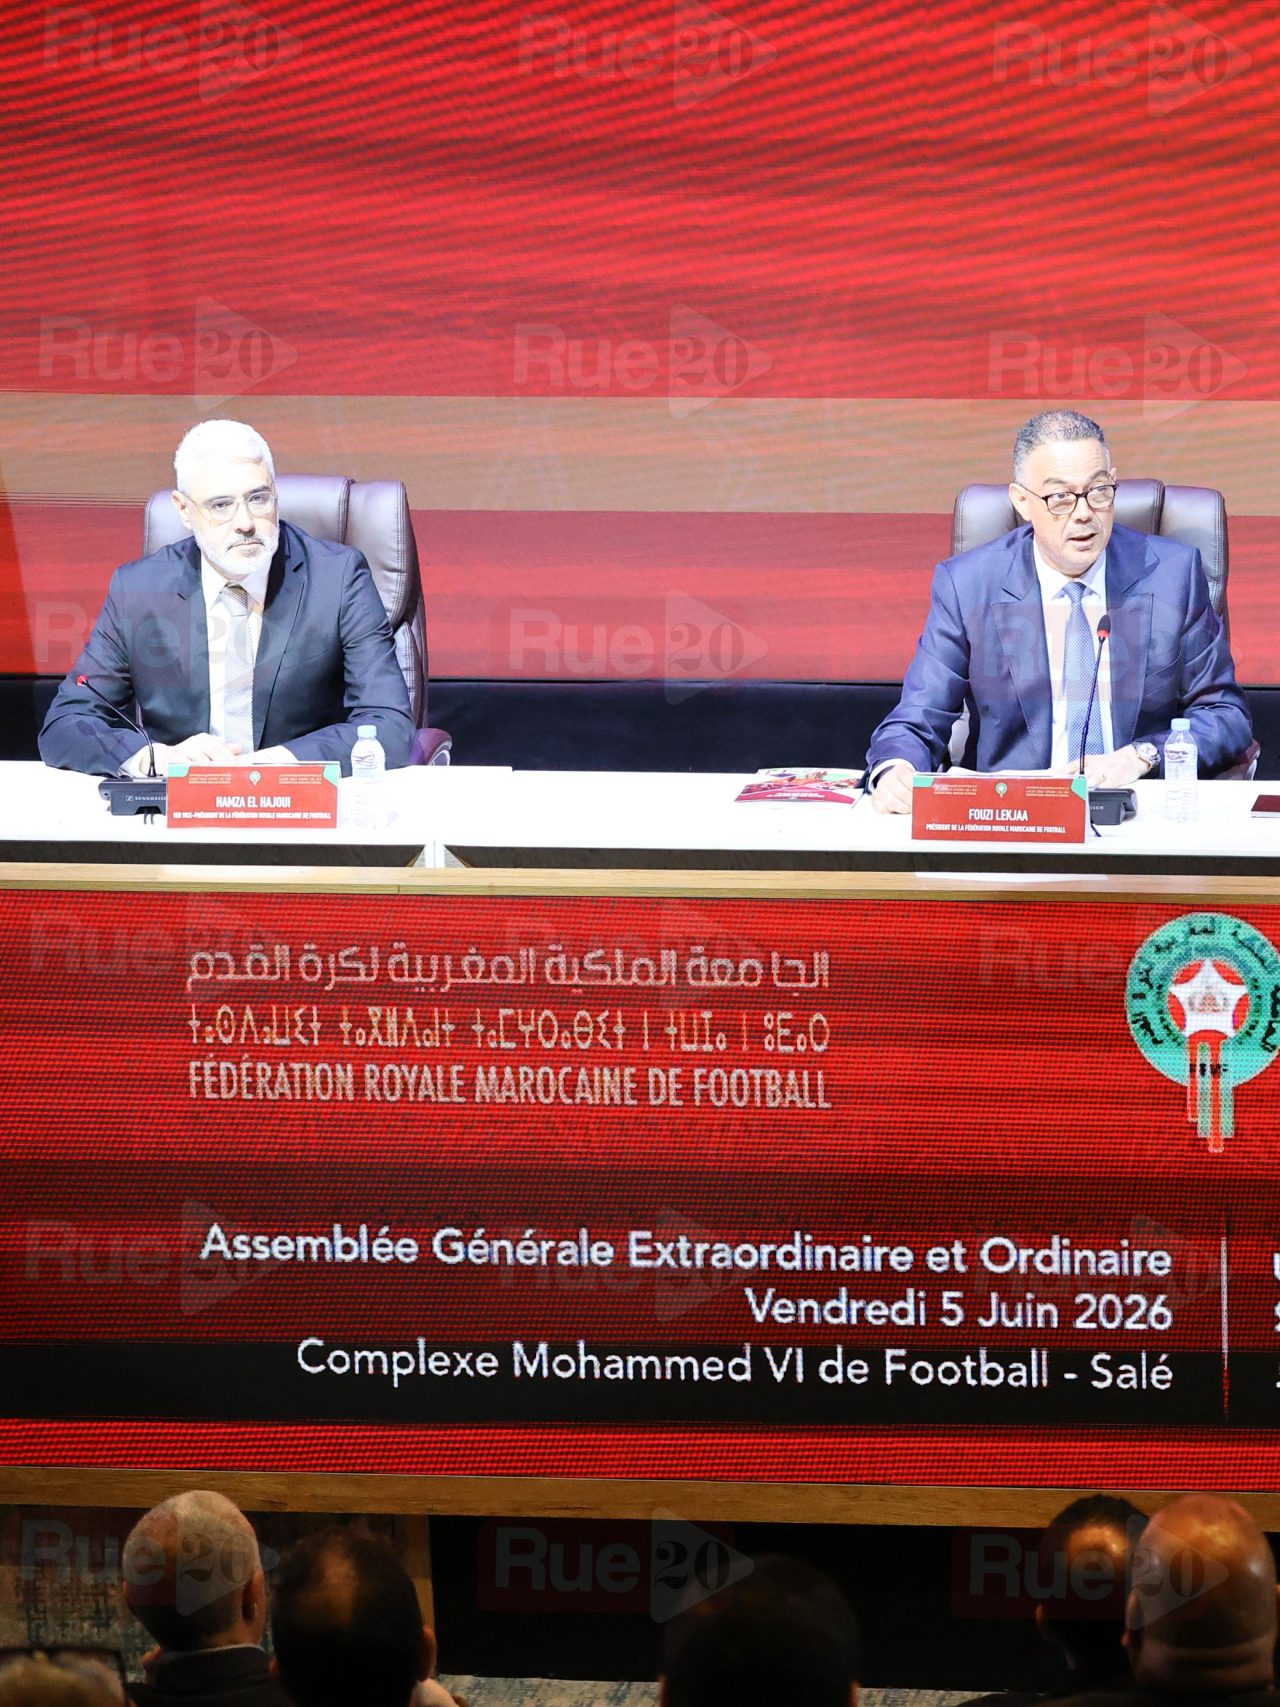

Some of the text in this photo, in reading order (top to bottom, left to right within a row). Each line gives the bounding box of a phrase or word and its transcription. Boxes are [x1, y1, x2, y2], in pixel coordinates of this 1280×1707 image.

[216, 796, 291, 808] HAMZA EL HAJOUI
[969, 809, 1028, 821] FOUZI LEKJAA
[185, 944, 290, 992] القدم
[299, 943, 378, 991] لكرة
[388, 942, 535, 992] المغربية
[545, 944, 677, 995] الملكية
[189, 1053, 832, 1109] FÉDÉRATION ROYALE MAROCAINE DE FOOTBALL
[199, 1223, 1172, 1277] Assemblée Générale Extraordinaire et Ordinaire
[744, 1286, 1173, 1331] Vendredi 5 Juin 2026
[297, 1337, 498, 1388] Complexe
[512, 1340, 752, 1382] Mohammed
[763, 1346, 803, 1383] VI
[819, 1344, 869, 1384] de
[885, 1347, 1049, 1388] Football
[1091, 1352, 1173, 1390] Salé
